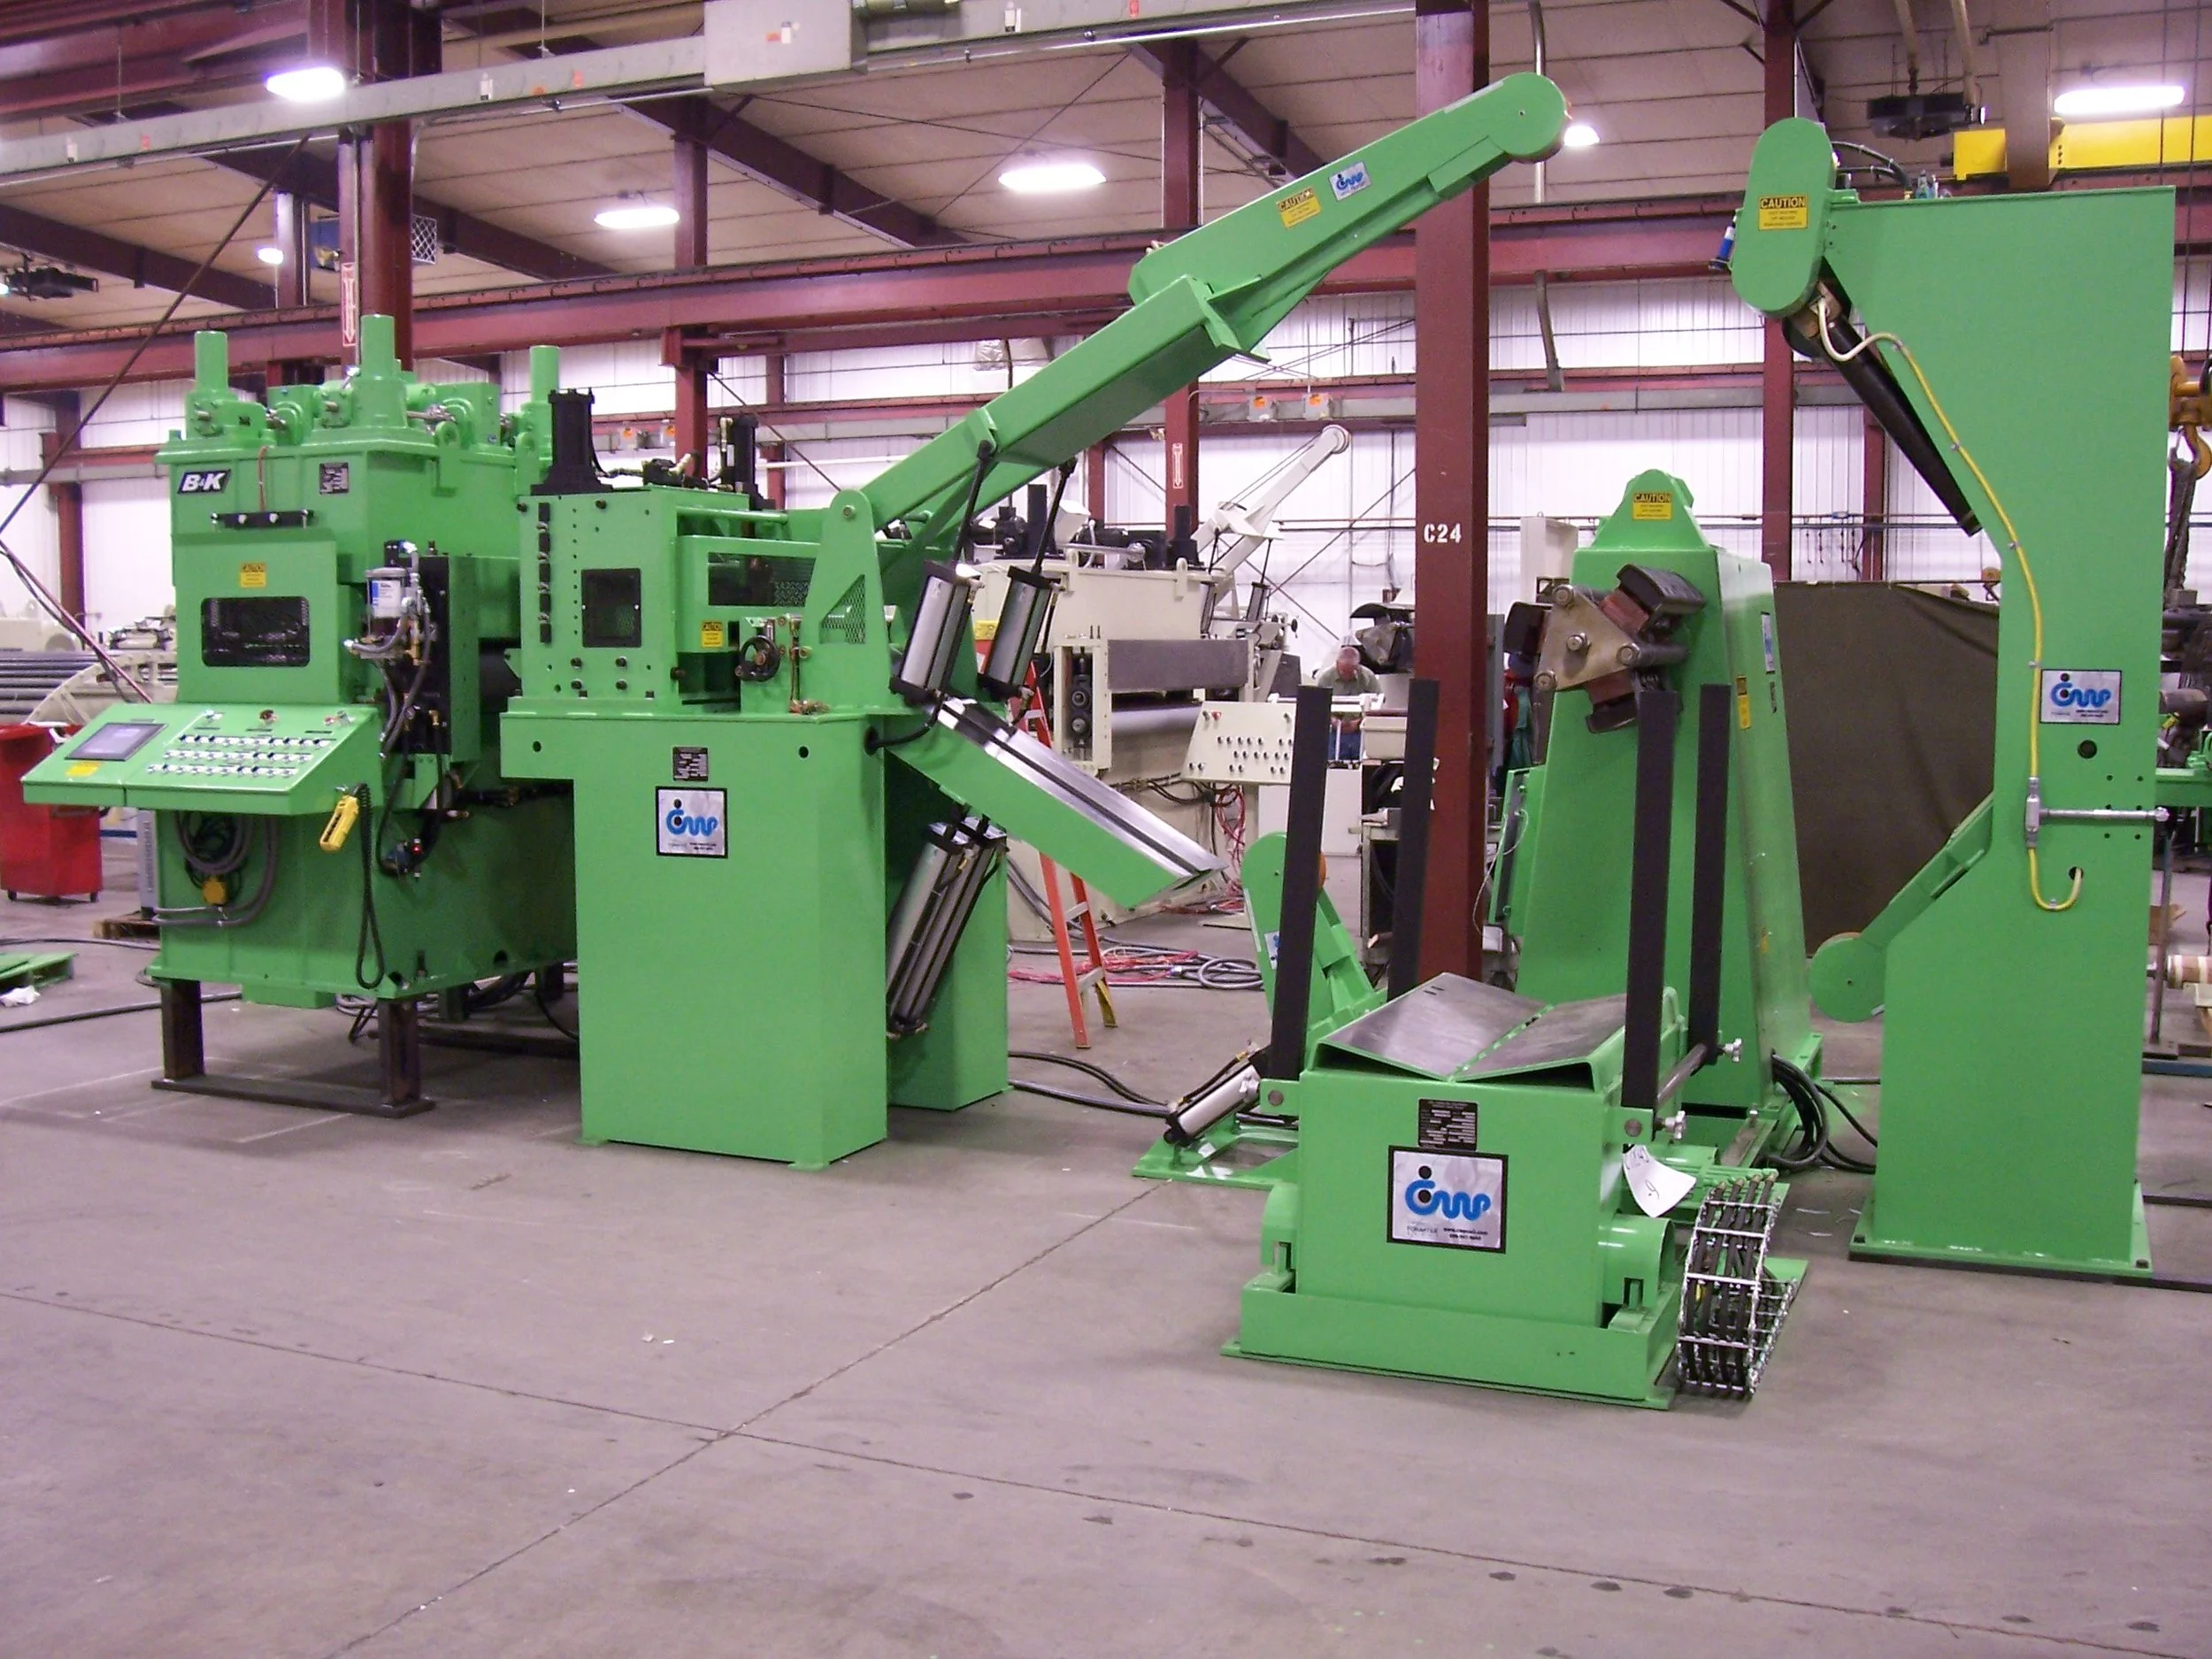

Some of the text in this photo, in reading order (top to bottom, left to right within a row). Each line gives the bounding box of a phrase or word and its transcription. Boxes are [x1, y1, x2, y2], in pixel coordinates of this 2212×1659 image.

[1761, 196, 1806, 210] CAUTION
[181, 472, 226, 492] B&K
[1423, 522, 1463, 544] C24
